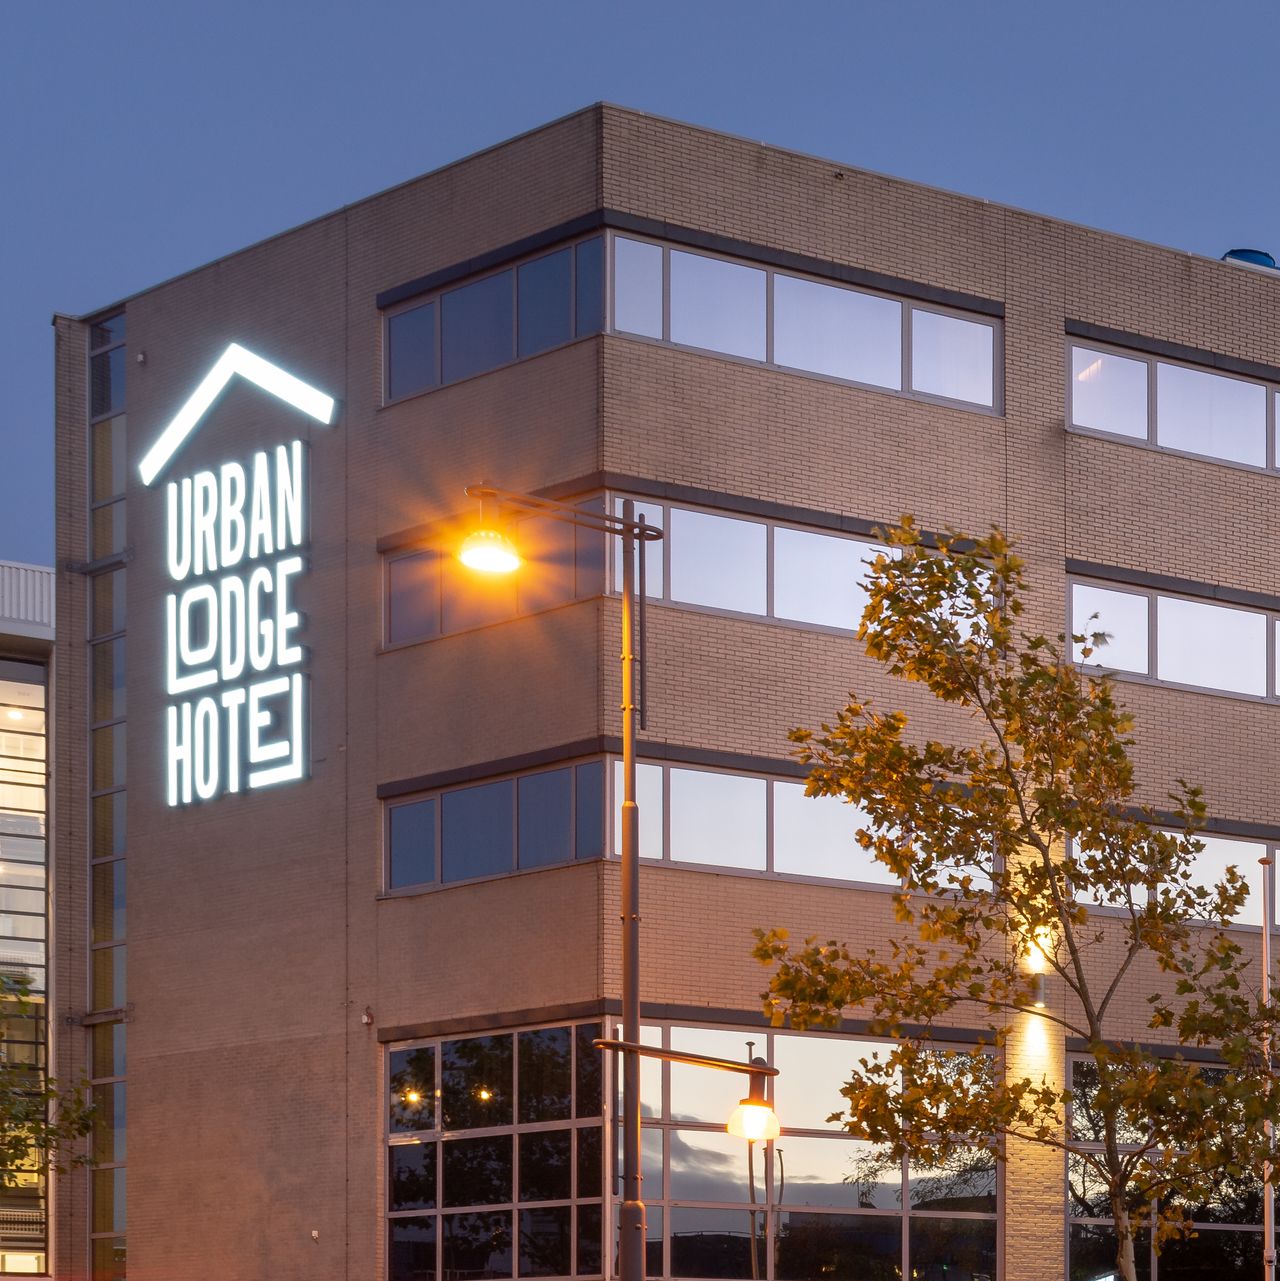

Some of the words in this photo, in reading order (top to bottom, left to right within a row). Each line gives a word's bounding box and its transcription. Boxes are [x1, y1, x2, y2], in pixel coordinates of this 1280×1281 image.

[167, 440, 302, 581] URBAN
[166, 556, 302, 695] LODGE
[167, 672, 303, 807] HOTEL
